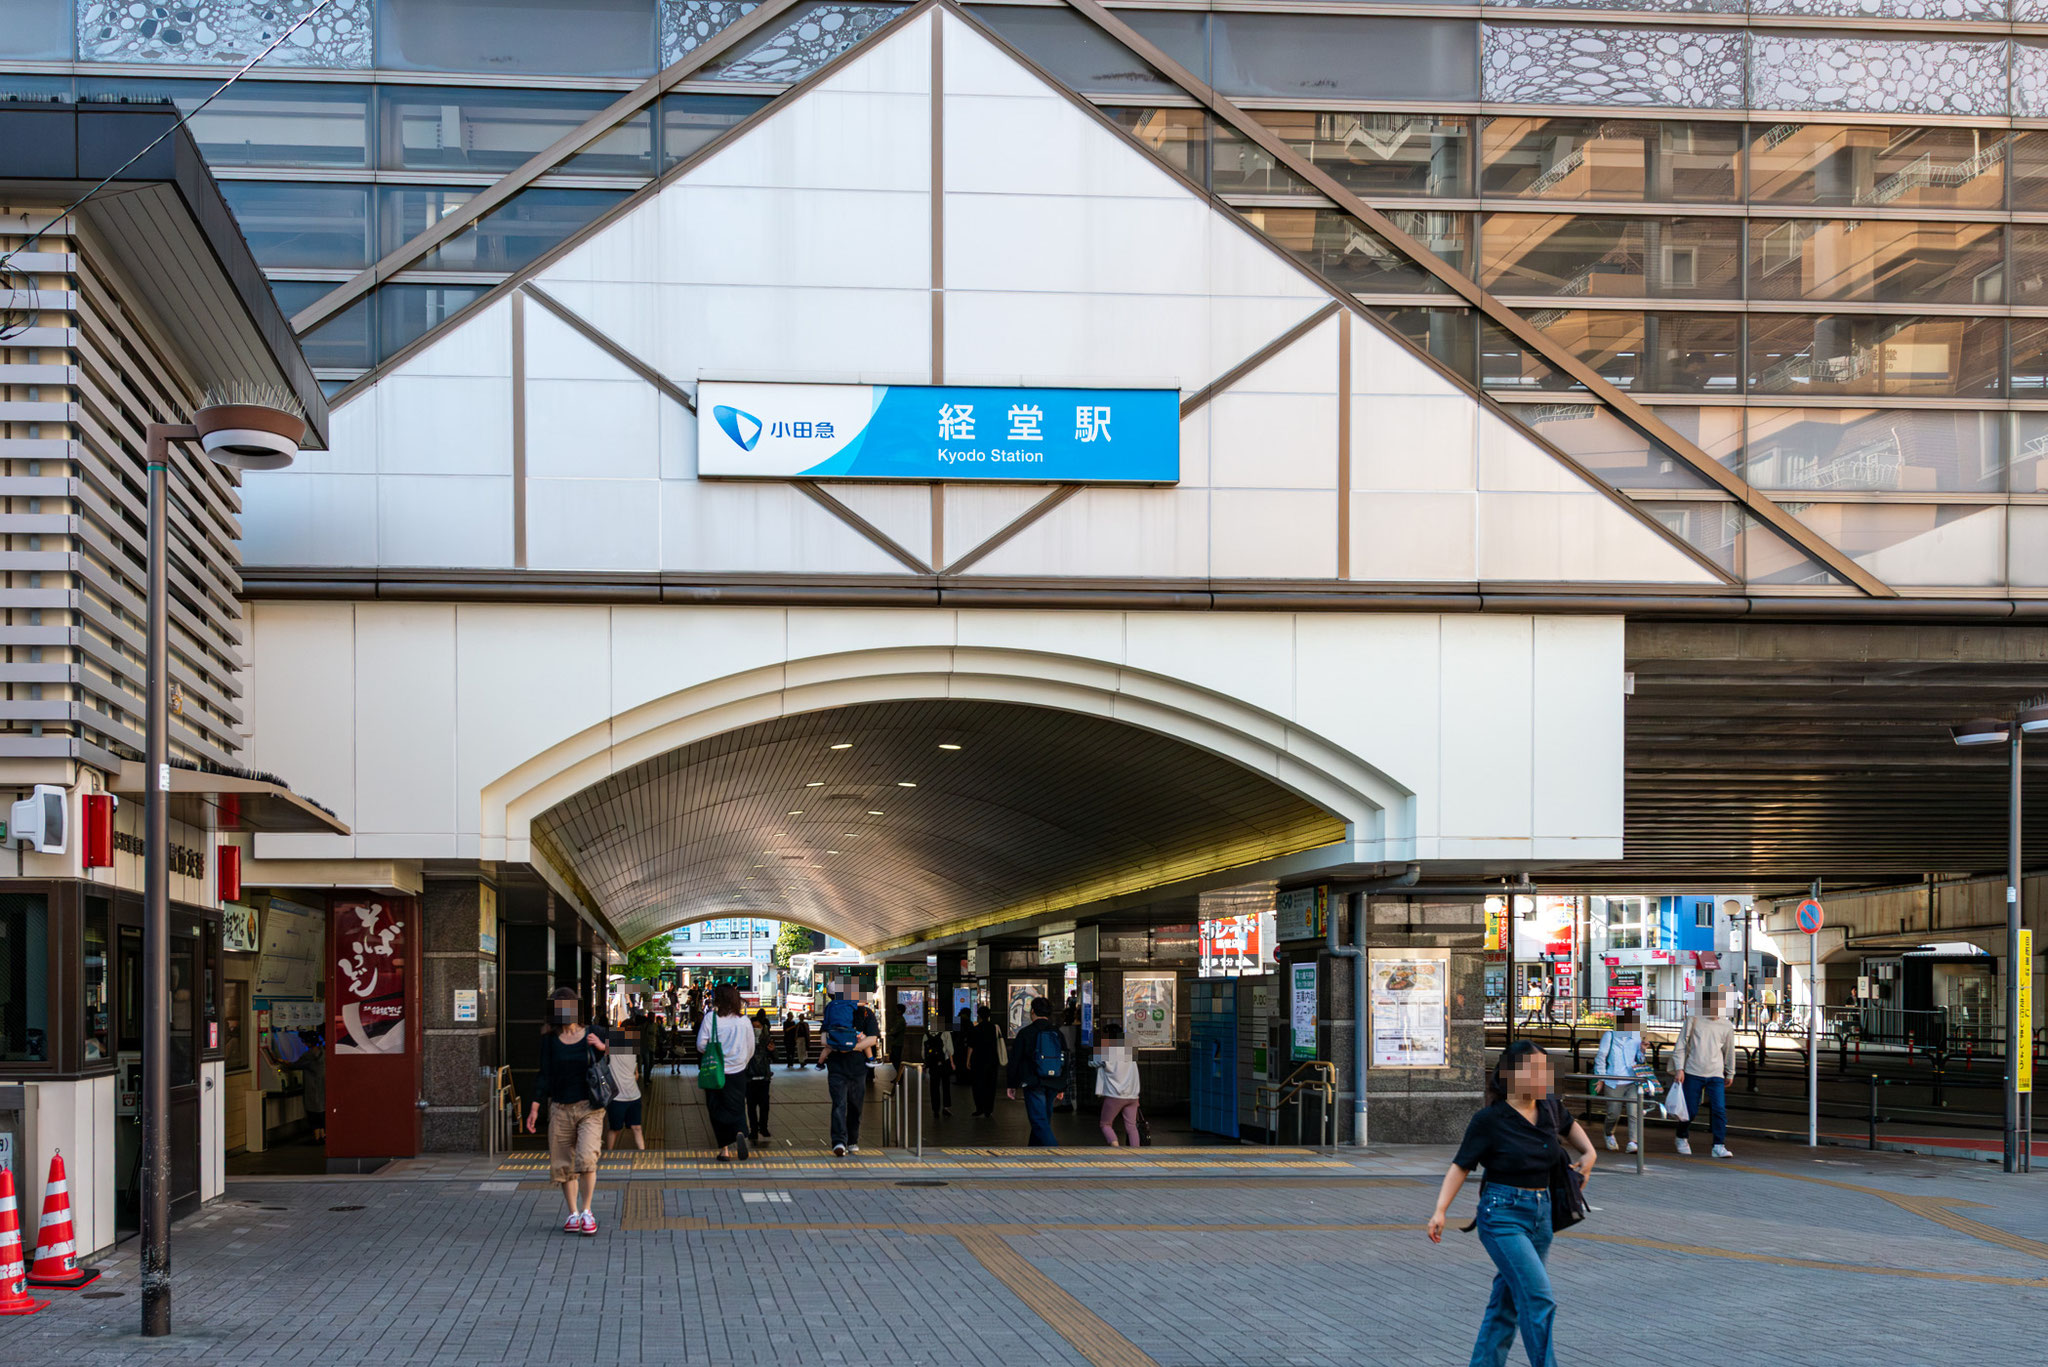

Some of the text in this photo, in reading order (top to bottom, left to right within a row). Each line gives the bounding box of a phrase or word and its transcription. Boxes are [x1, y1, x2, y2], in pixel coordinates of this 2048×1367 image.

[770, 420, 836, 440] 小田急
[938, 403, 1112, 443] 経堂駅
[938, 448, 1044, 466] Kyodo Station
[354, 903, 405, 957] そば
[337, 941, 378, 998] うどん
